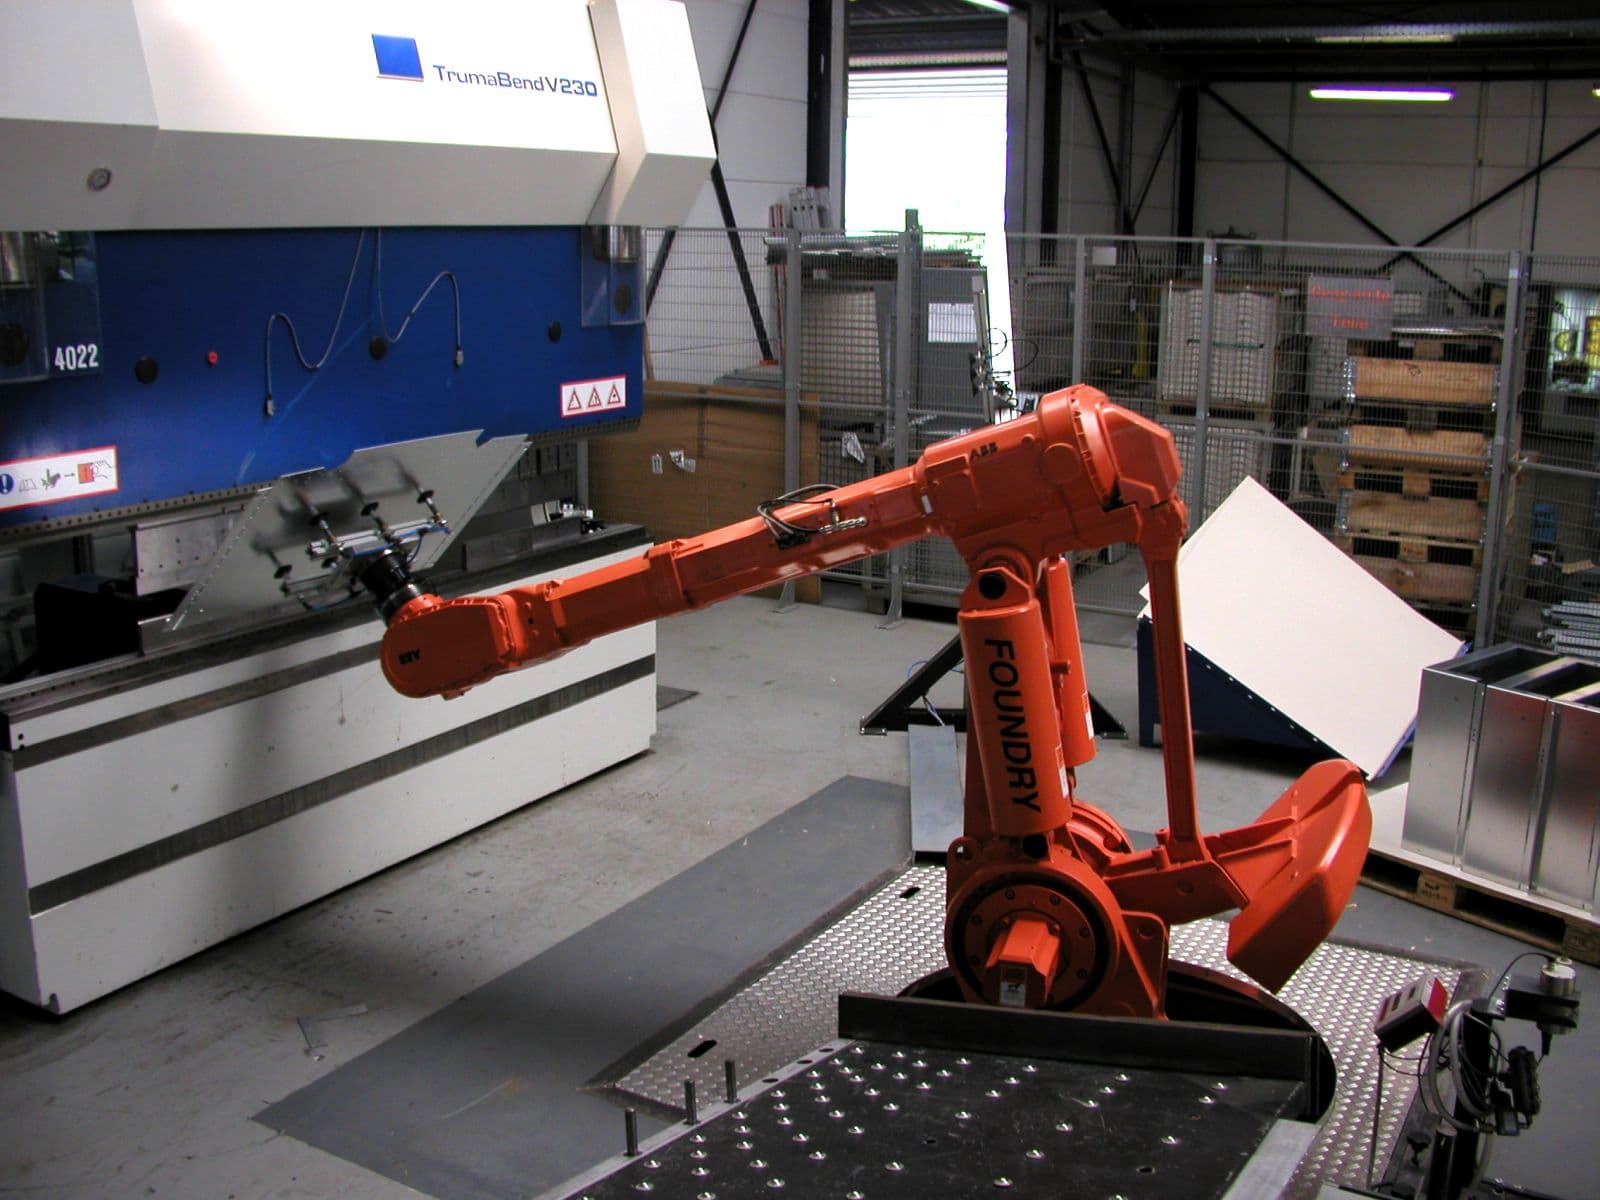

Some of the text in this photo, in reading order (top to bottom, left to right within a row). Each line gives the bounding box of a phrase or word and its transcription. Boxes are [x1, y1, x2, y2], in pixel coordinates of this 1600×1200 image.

[54, 343, 99, 370] 4022
[969, 441, 998, 461] ABB
[984, 639, 1041, 813] FOUNDRY
